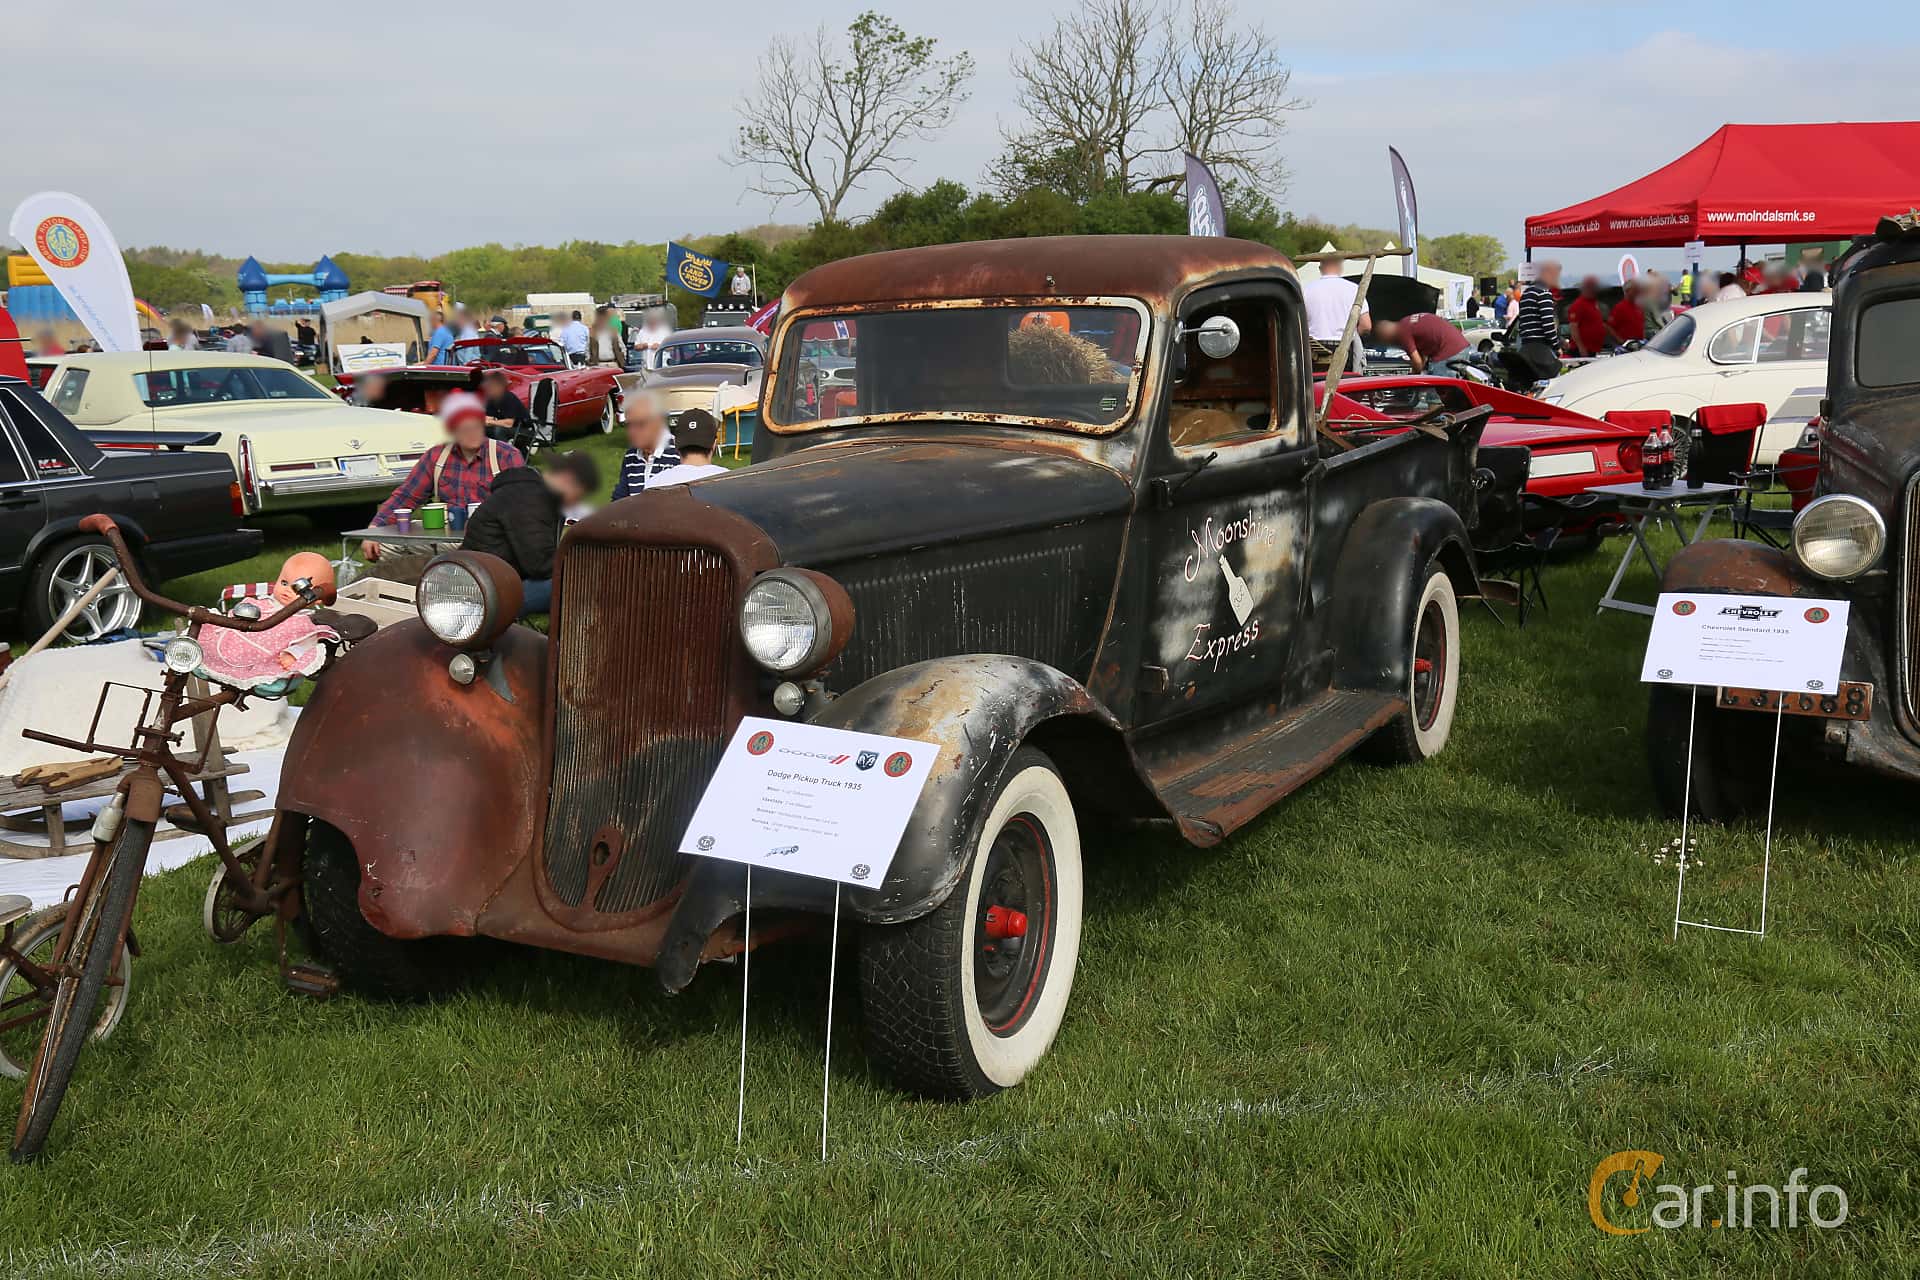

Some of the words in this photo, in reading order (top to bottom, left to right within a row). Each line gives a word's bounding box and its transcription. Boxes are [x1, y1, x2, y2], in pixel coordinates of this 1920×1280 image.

[1707, 210, 1816, 222] www.molndalsmk.se
[684, 266, 704, 277] LAND
[685, 274, 709, 285] ROVER
[1184, 510, 1276, 583] Moonshine
[1725, 608, 1775, 617] CHEVROLET
[1184, 619, 1260, 673] Express
[767, 769, 791, 780] Dodge
[793, 773, 819, 784] Pickup
[821, 778, 842, 788] Truck
[844, 782, 862, 791] 1935
